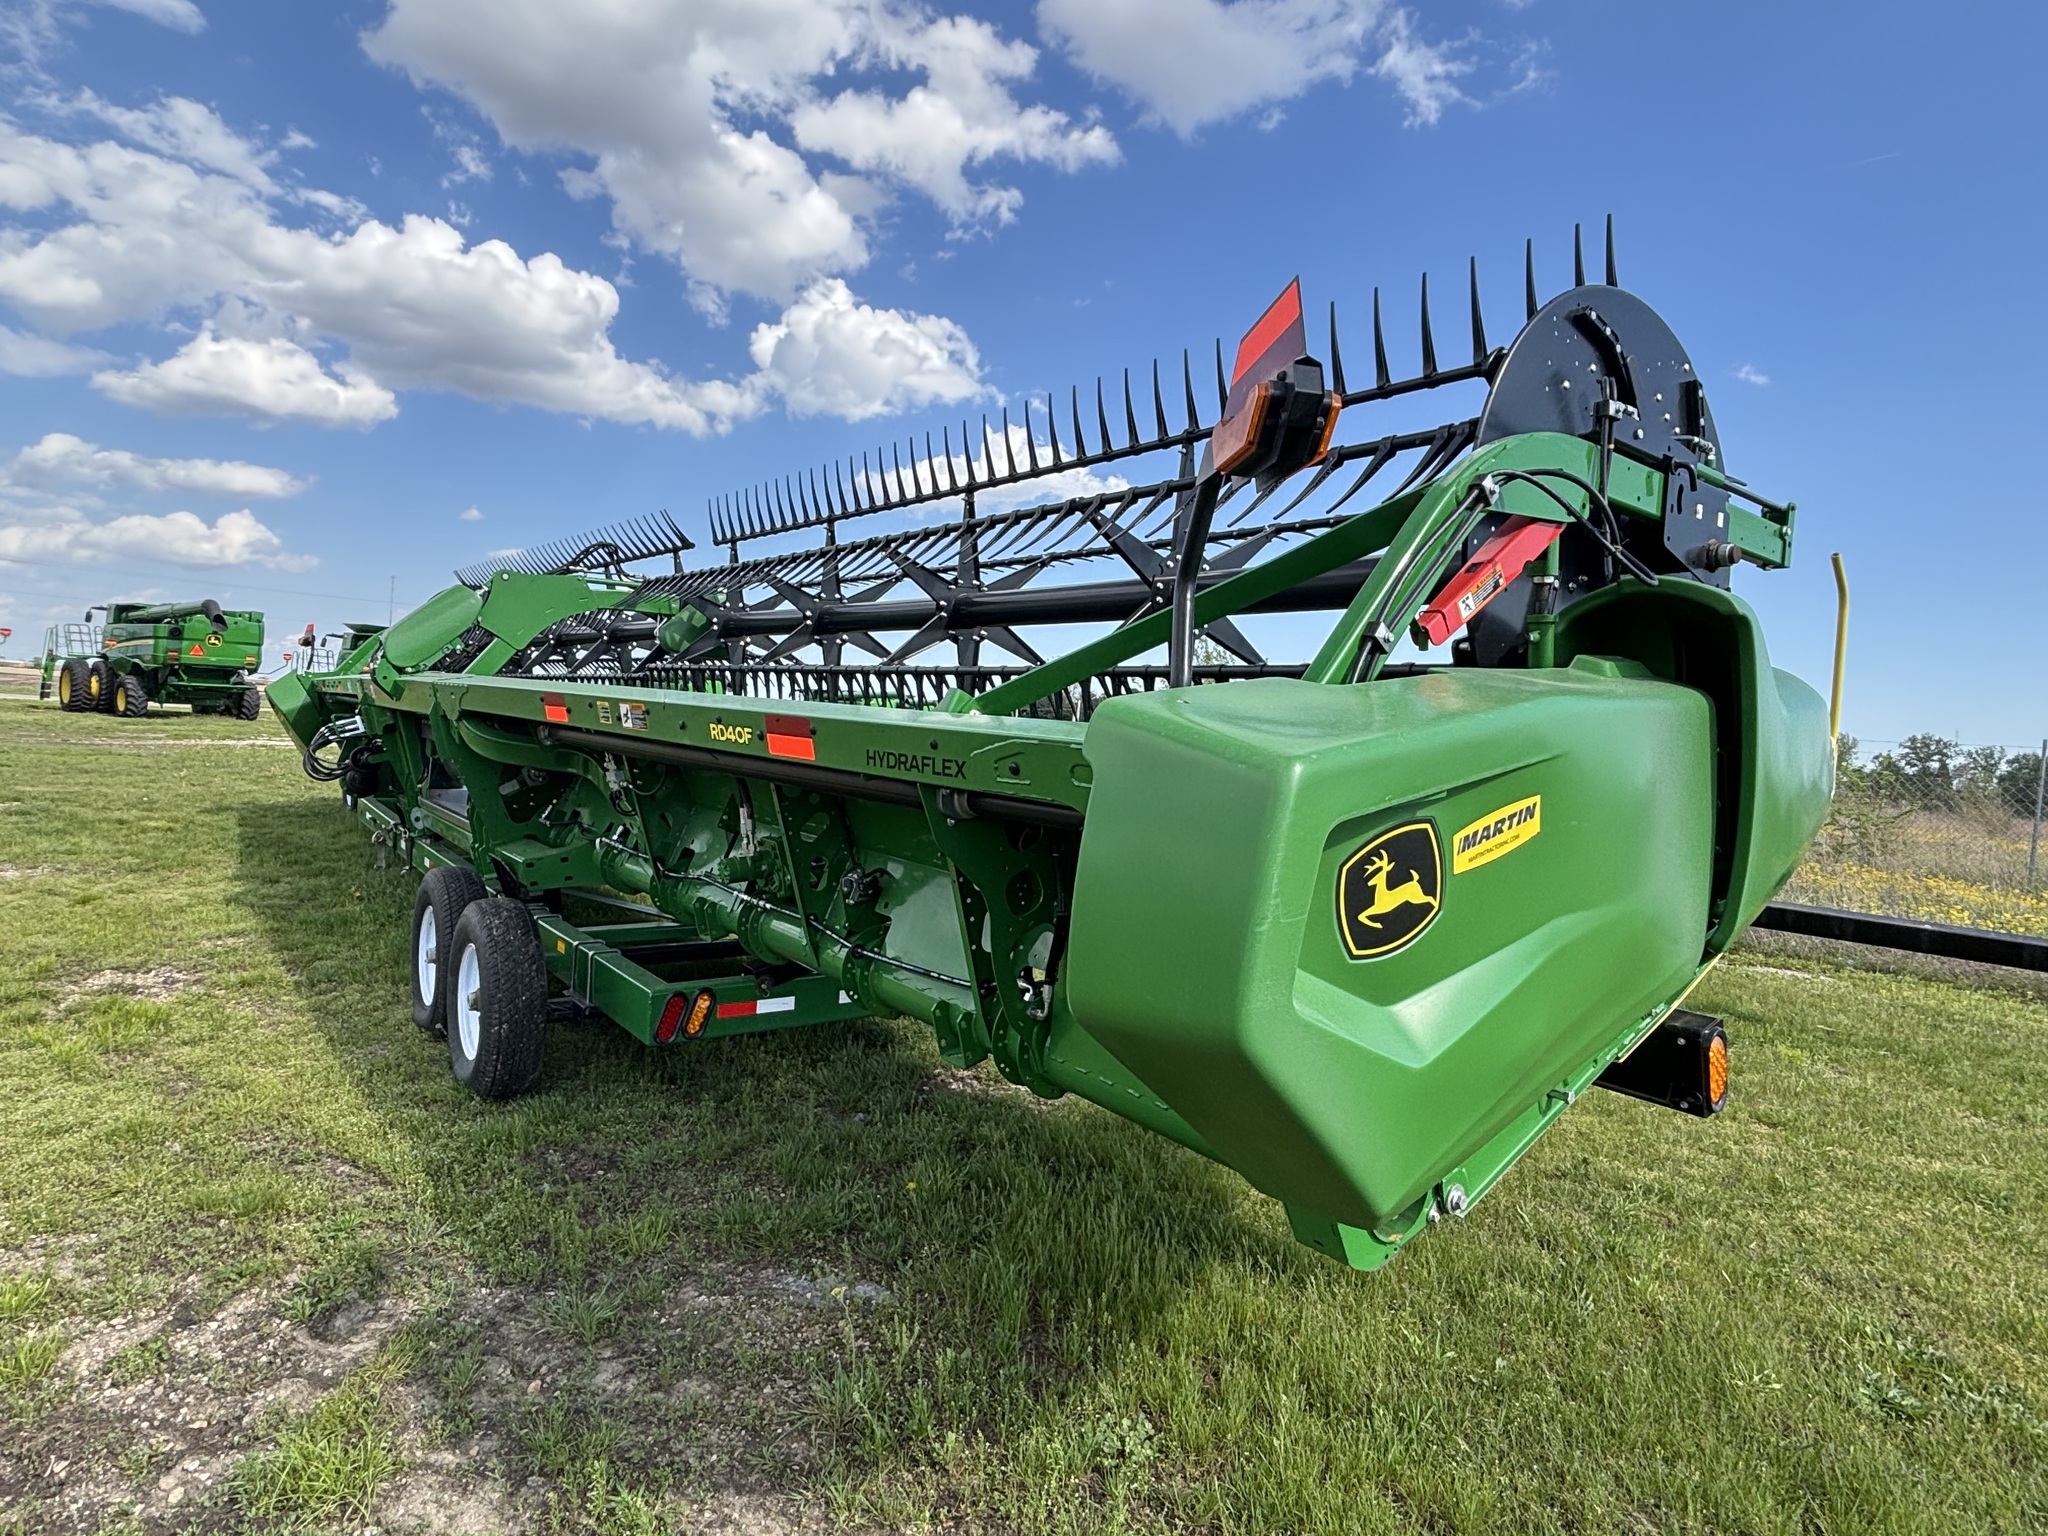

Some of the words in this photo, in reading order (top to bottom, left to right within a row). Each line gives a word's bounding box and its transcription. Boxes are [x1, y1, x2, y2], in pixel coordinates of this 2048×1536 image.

[709, 723, 753, 744] RD40F
[866, 749, 967, 779] HYDRAFLEX
[1460, 801, 1537, 854] MARTIN
